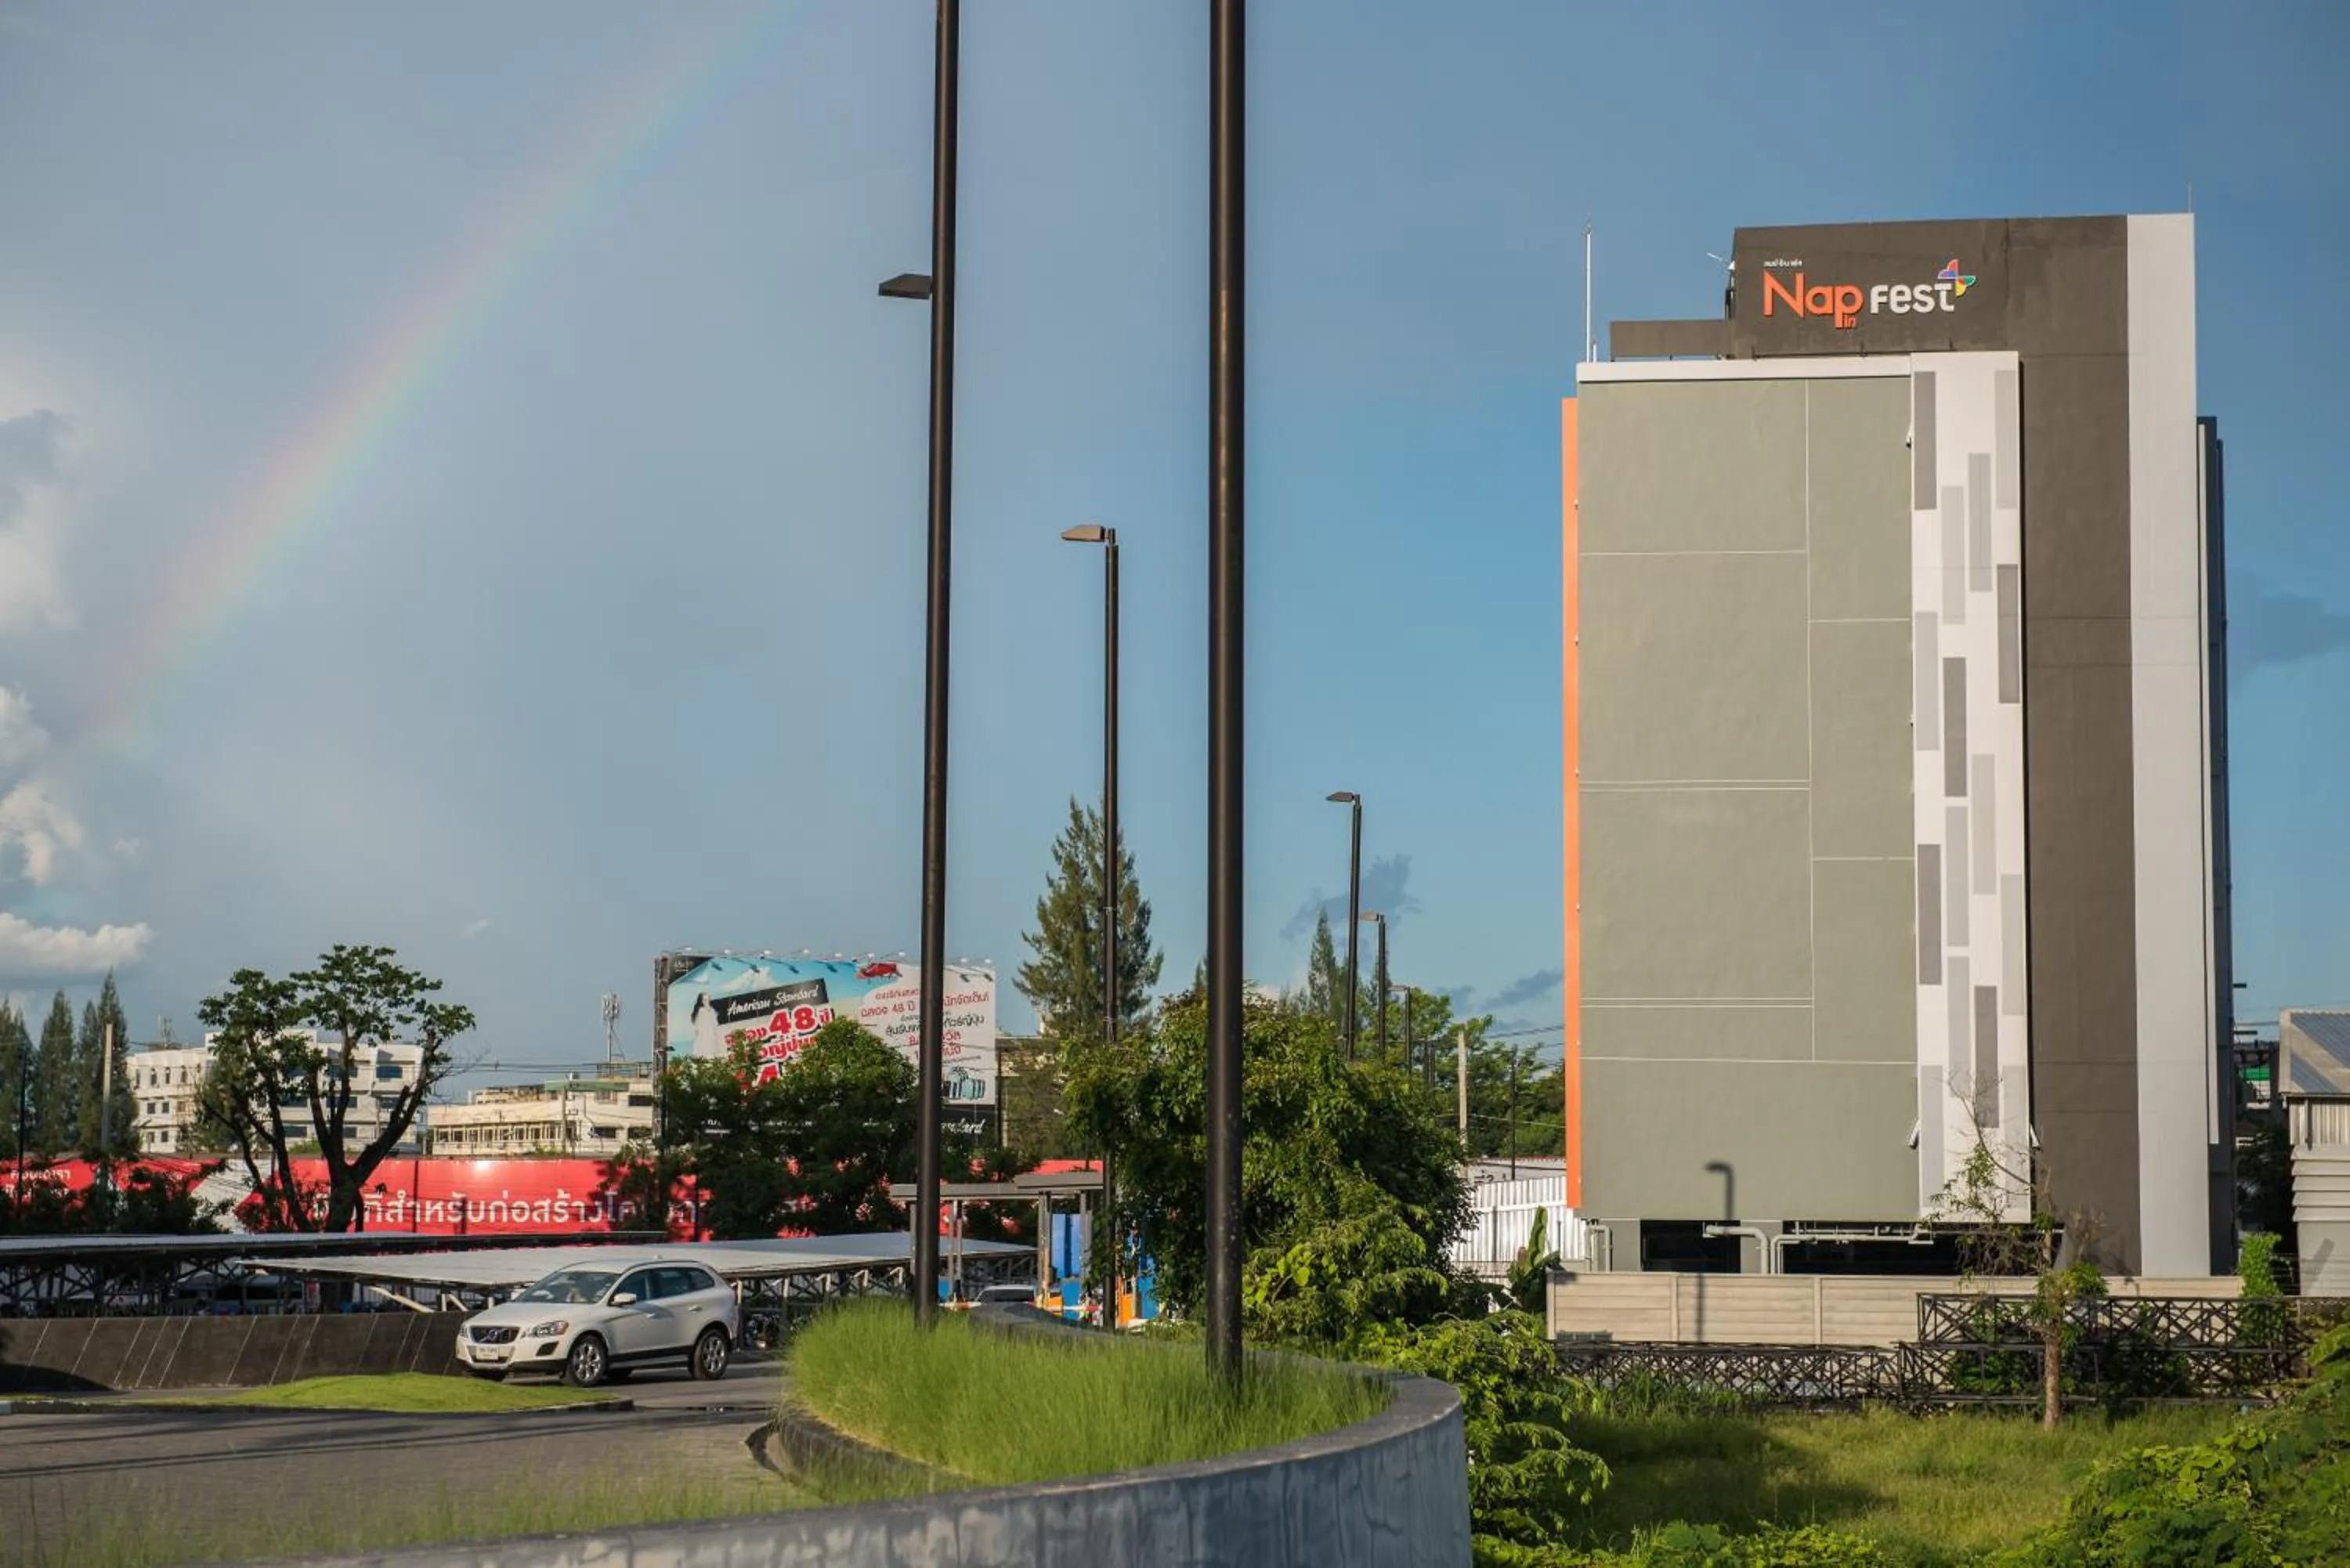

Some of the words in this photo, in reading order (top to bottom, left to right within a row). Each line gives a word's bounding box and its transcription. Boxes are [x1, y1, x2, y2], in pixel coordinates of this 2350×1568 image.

[1763, 271, 1864, 328] Nap
[727, 999, 771, 1016] American
[774, 985, 819, 1006] Standard
[891, 1003, 905, 1013] 48
[769, 1006, 815, 1035] 48
